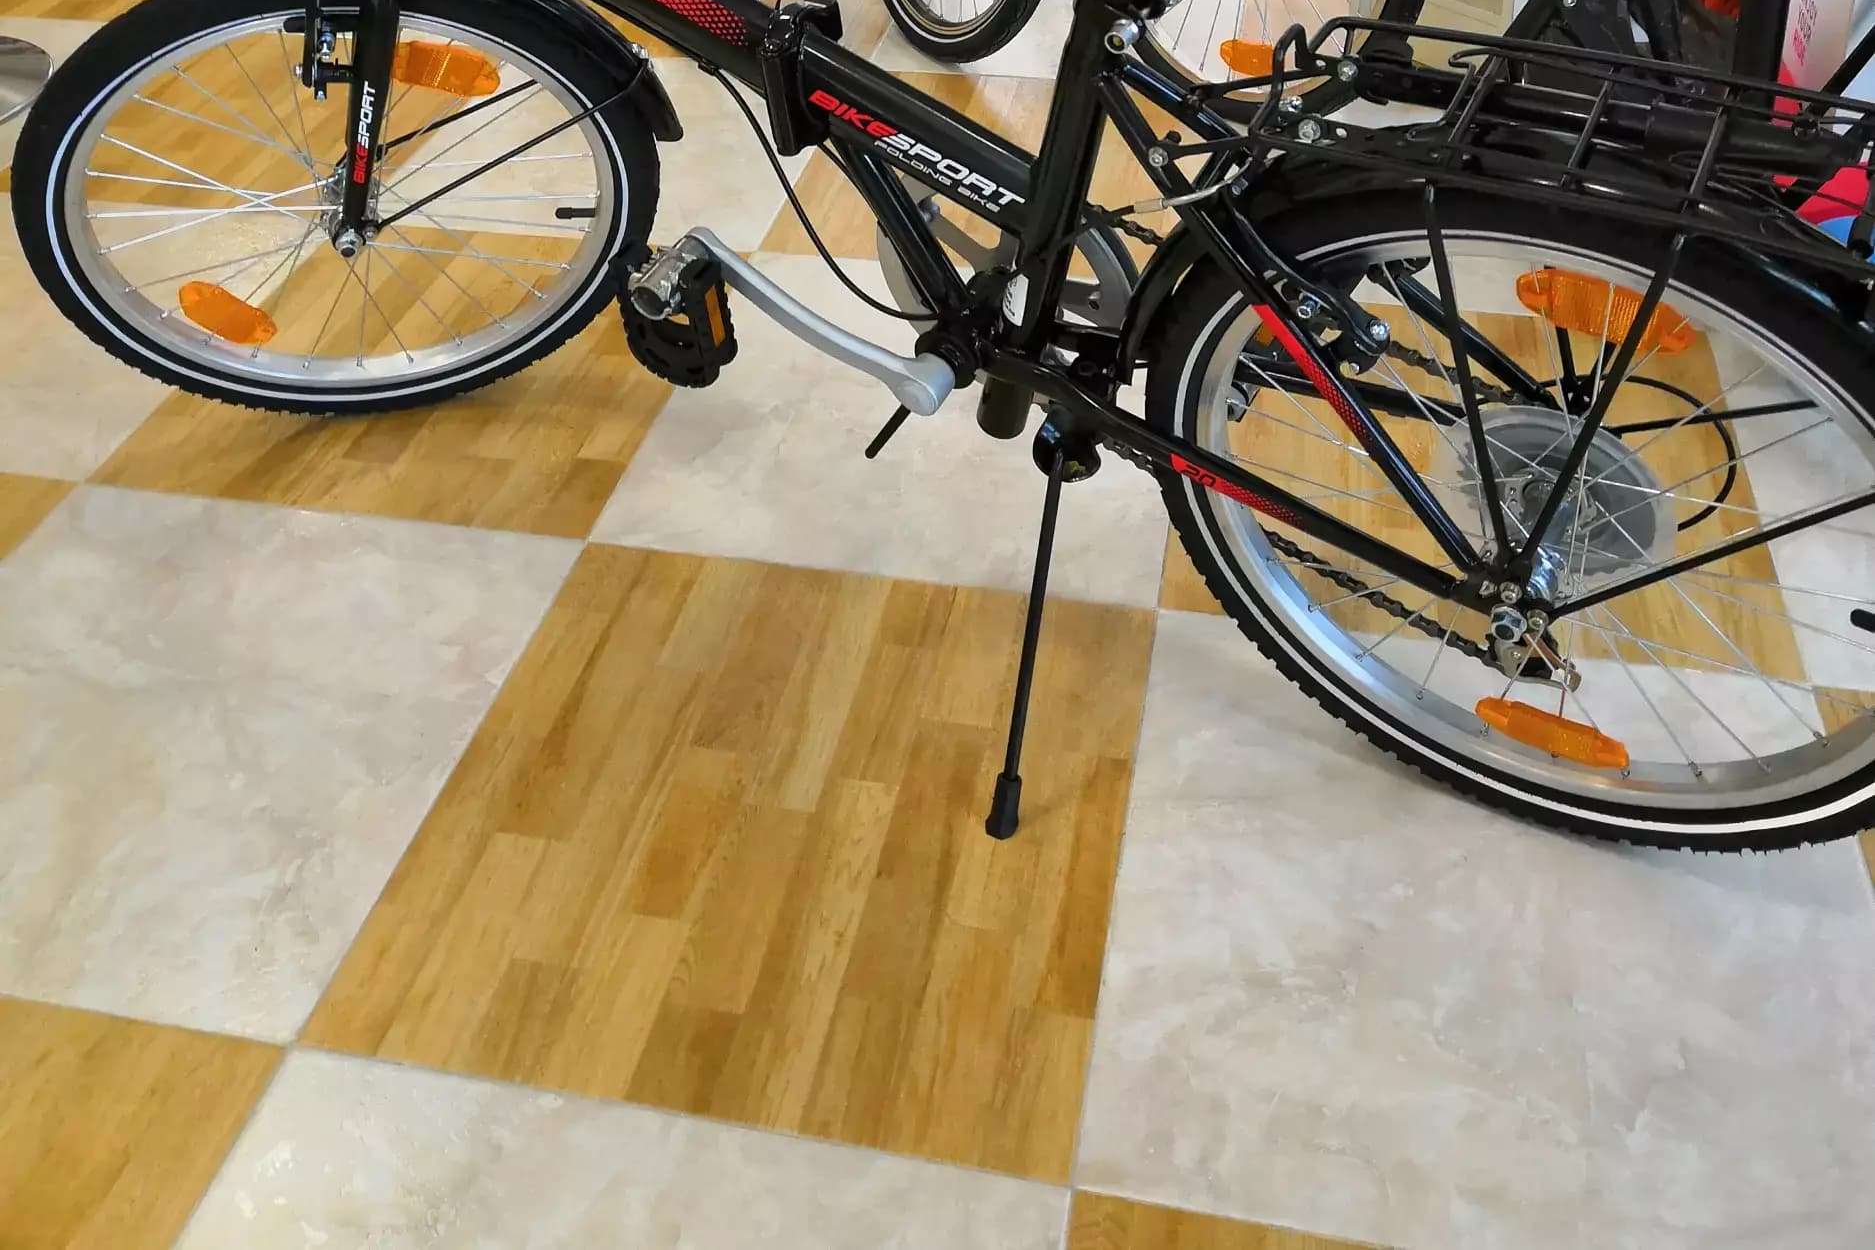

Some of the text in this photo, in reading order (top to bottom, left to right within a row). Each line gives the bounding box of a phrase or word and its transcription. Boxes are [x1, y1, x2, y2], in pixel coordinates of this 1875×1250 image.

[873, 140, 1001, 214] FOLDING BIKE
[1182, 464, 1217, 488] 20
